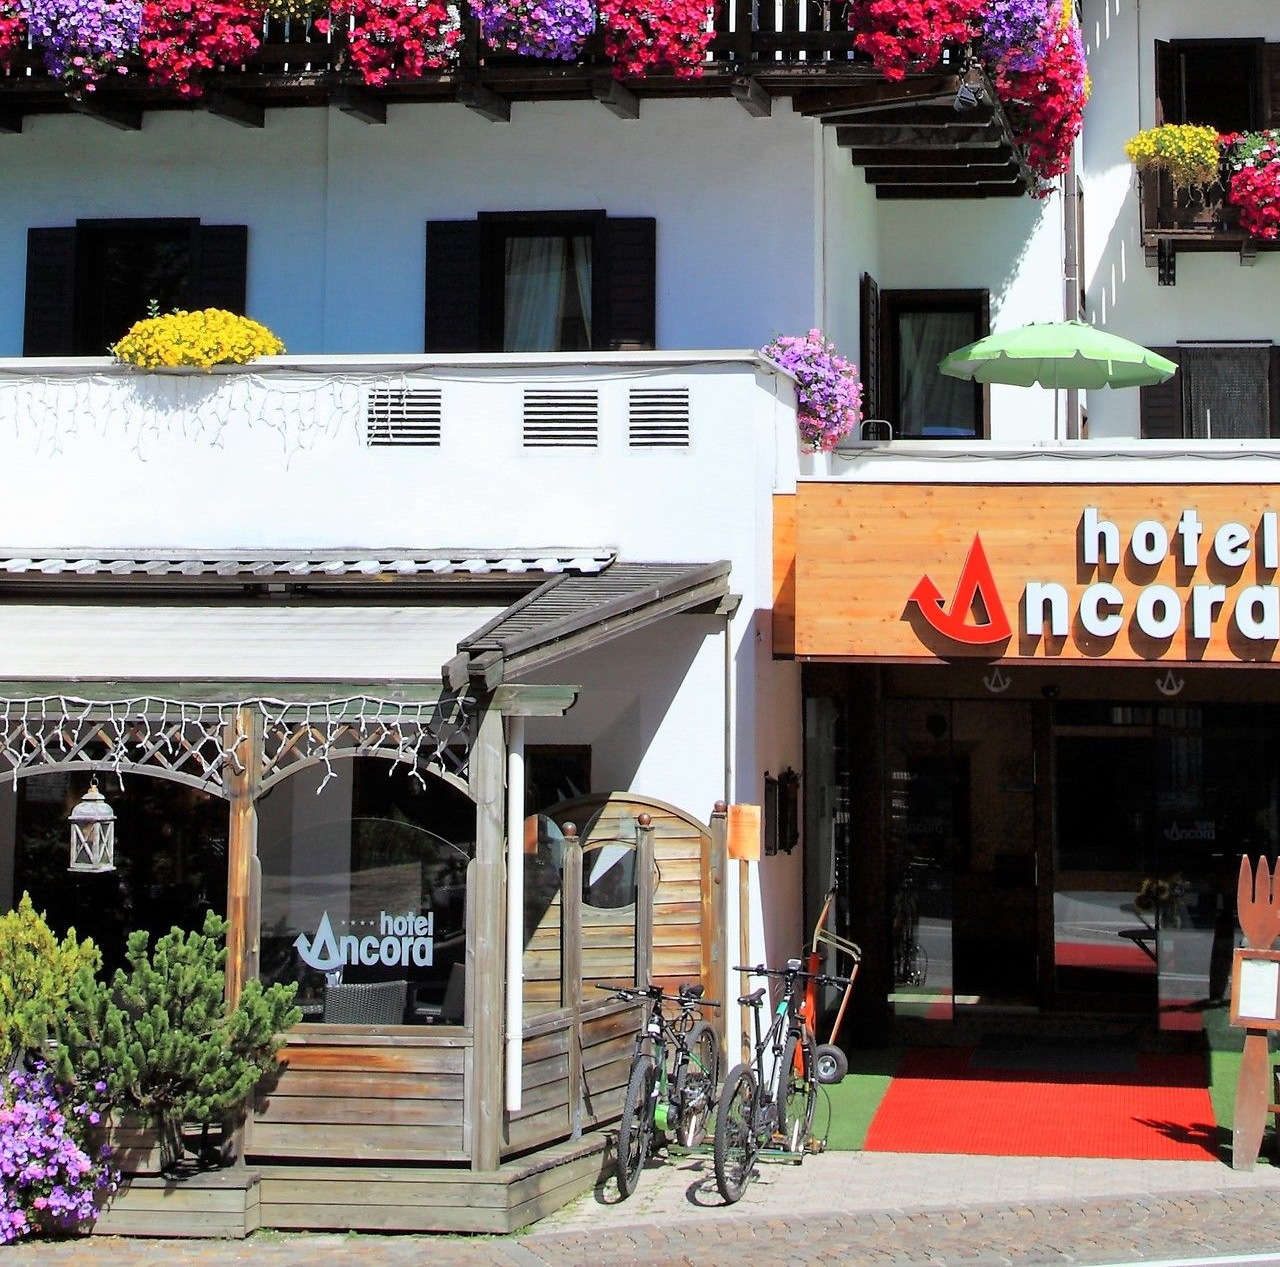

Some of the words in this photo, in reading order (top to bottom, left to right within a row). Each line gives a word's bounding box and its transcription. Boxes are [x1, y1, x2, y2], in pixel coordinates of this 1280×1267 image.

[1083, 508, 1278, 569] hotel
[293, 910, 434, 971] Ancora
[380, 911, 434, 936] hotel
